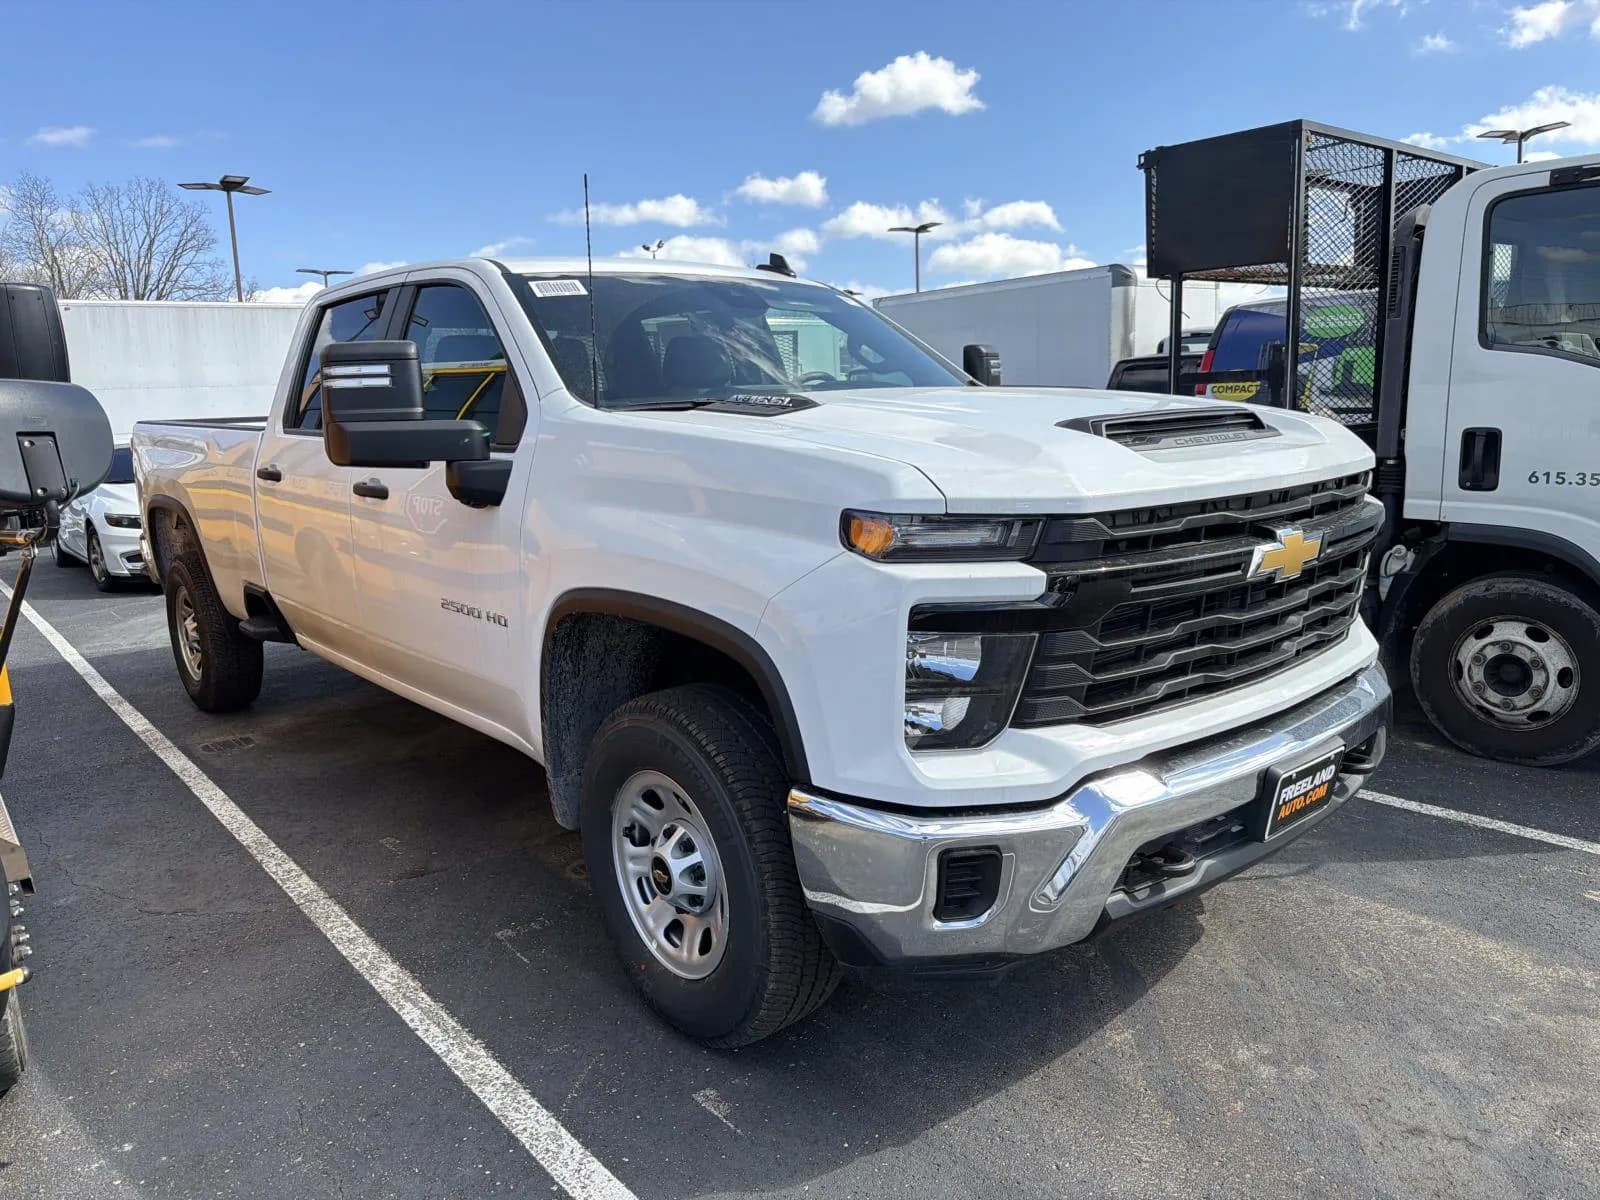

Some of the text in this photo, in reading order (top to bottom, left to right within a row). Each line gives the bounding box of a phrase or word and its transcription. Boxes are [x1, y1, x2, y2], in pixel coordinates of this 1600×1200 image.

[1211, 384, 1260, 394] COMPACT
[1174, 432, 1249, 446] CHEVROLET
[440, 598, 508, 628] 2500 HD
[1279, 765, 1335, 805] FREELAND
[1278, 783, 1328, 821] AUTO.COM
